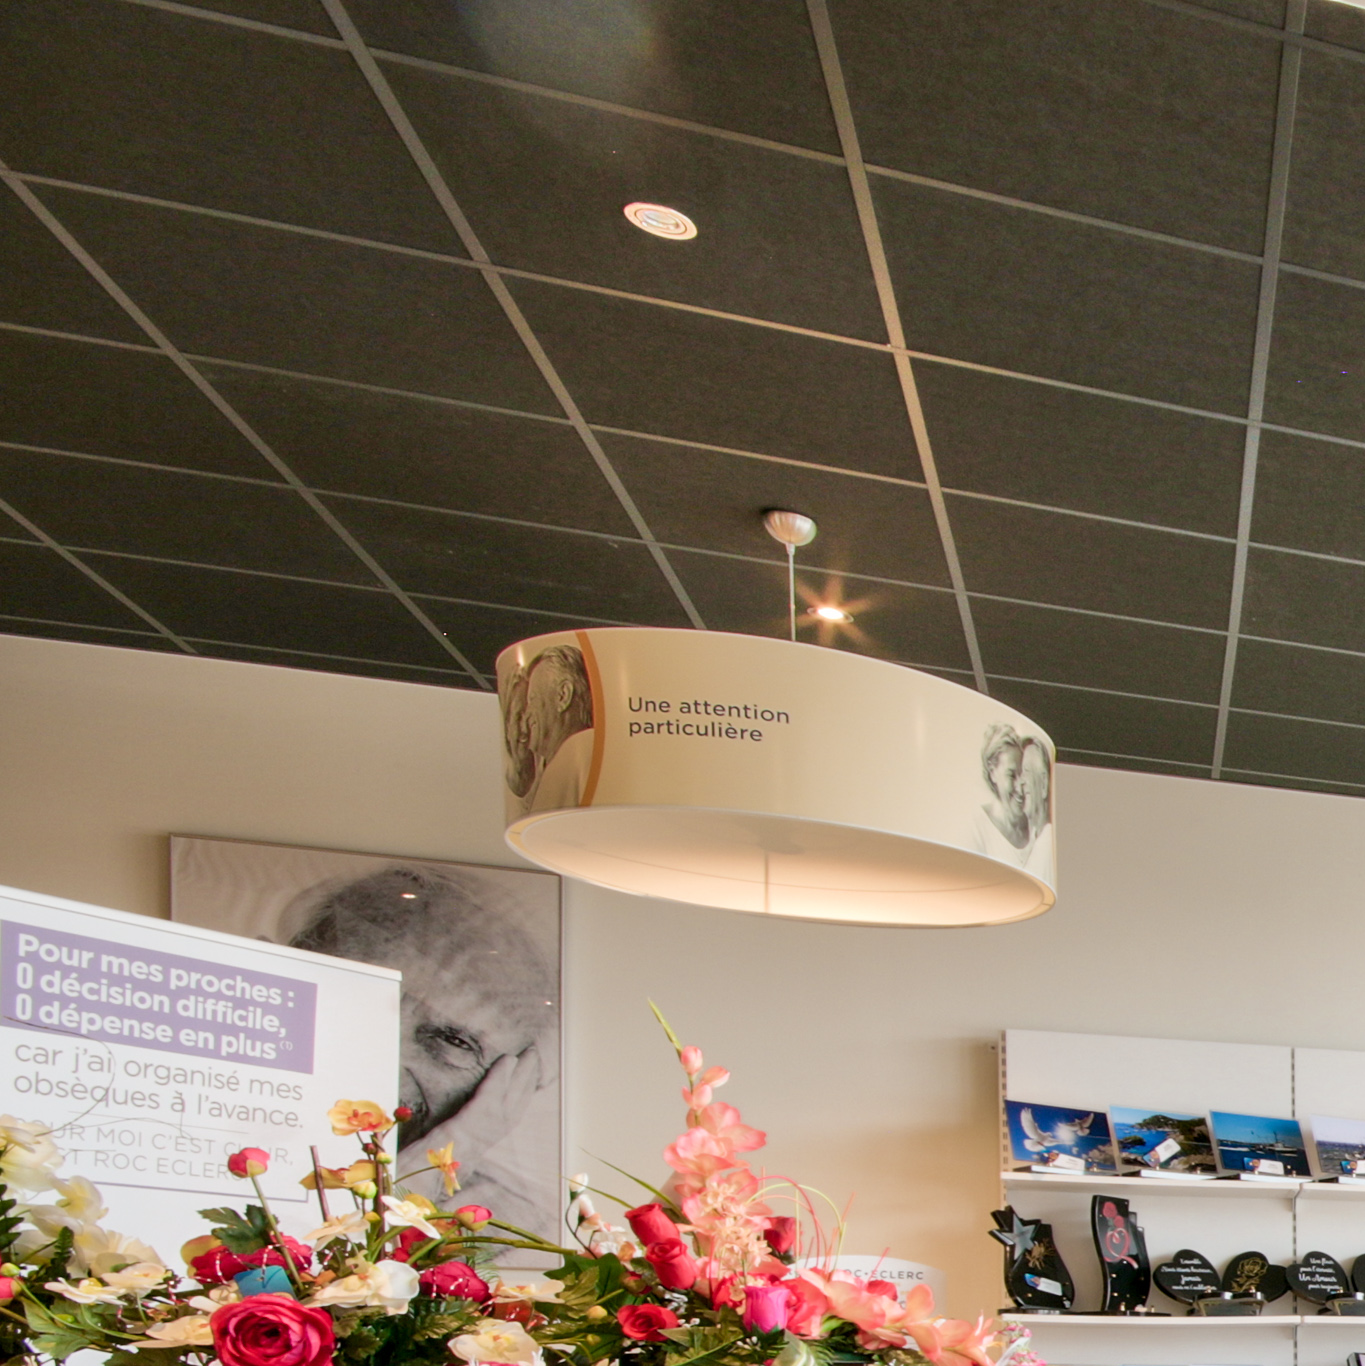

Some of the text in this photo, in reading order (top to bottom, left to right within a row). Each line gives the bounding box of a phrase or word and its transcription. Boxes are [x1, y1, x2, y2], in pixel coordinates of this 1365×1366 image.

[628, 697, 790, 724] Une attention
[629, 719, 763, 742] particulière
[18, 933, 94, 969] Pour
[100, 954, 164, 983] mes
[169, 967, 282, 1005] proches
[15, 993, 33, 1021] 0
[38, 1001, 173, 1043] dépense
[179, 1028, 215, 1050] en
[220, 1032, 277, 1060] plus
[17, 961, 287, 1038] 0 décision difficile,
[14, 1043, 303, 1101] car j'ai organisé mes
[14, 1071, 304, 1129] obsèques à l'avance.
[94, 1150, 148, 1172] ROC
[97, 1127, 142, 1147] MOI
[151, 1133, 216, 1155] C'EST
